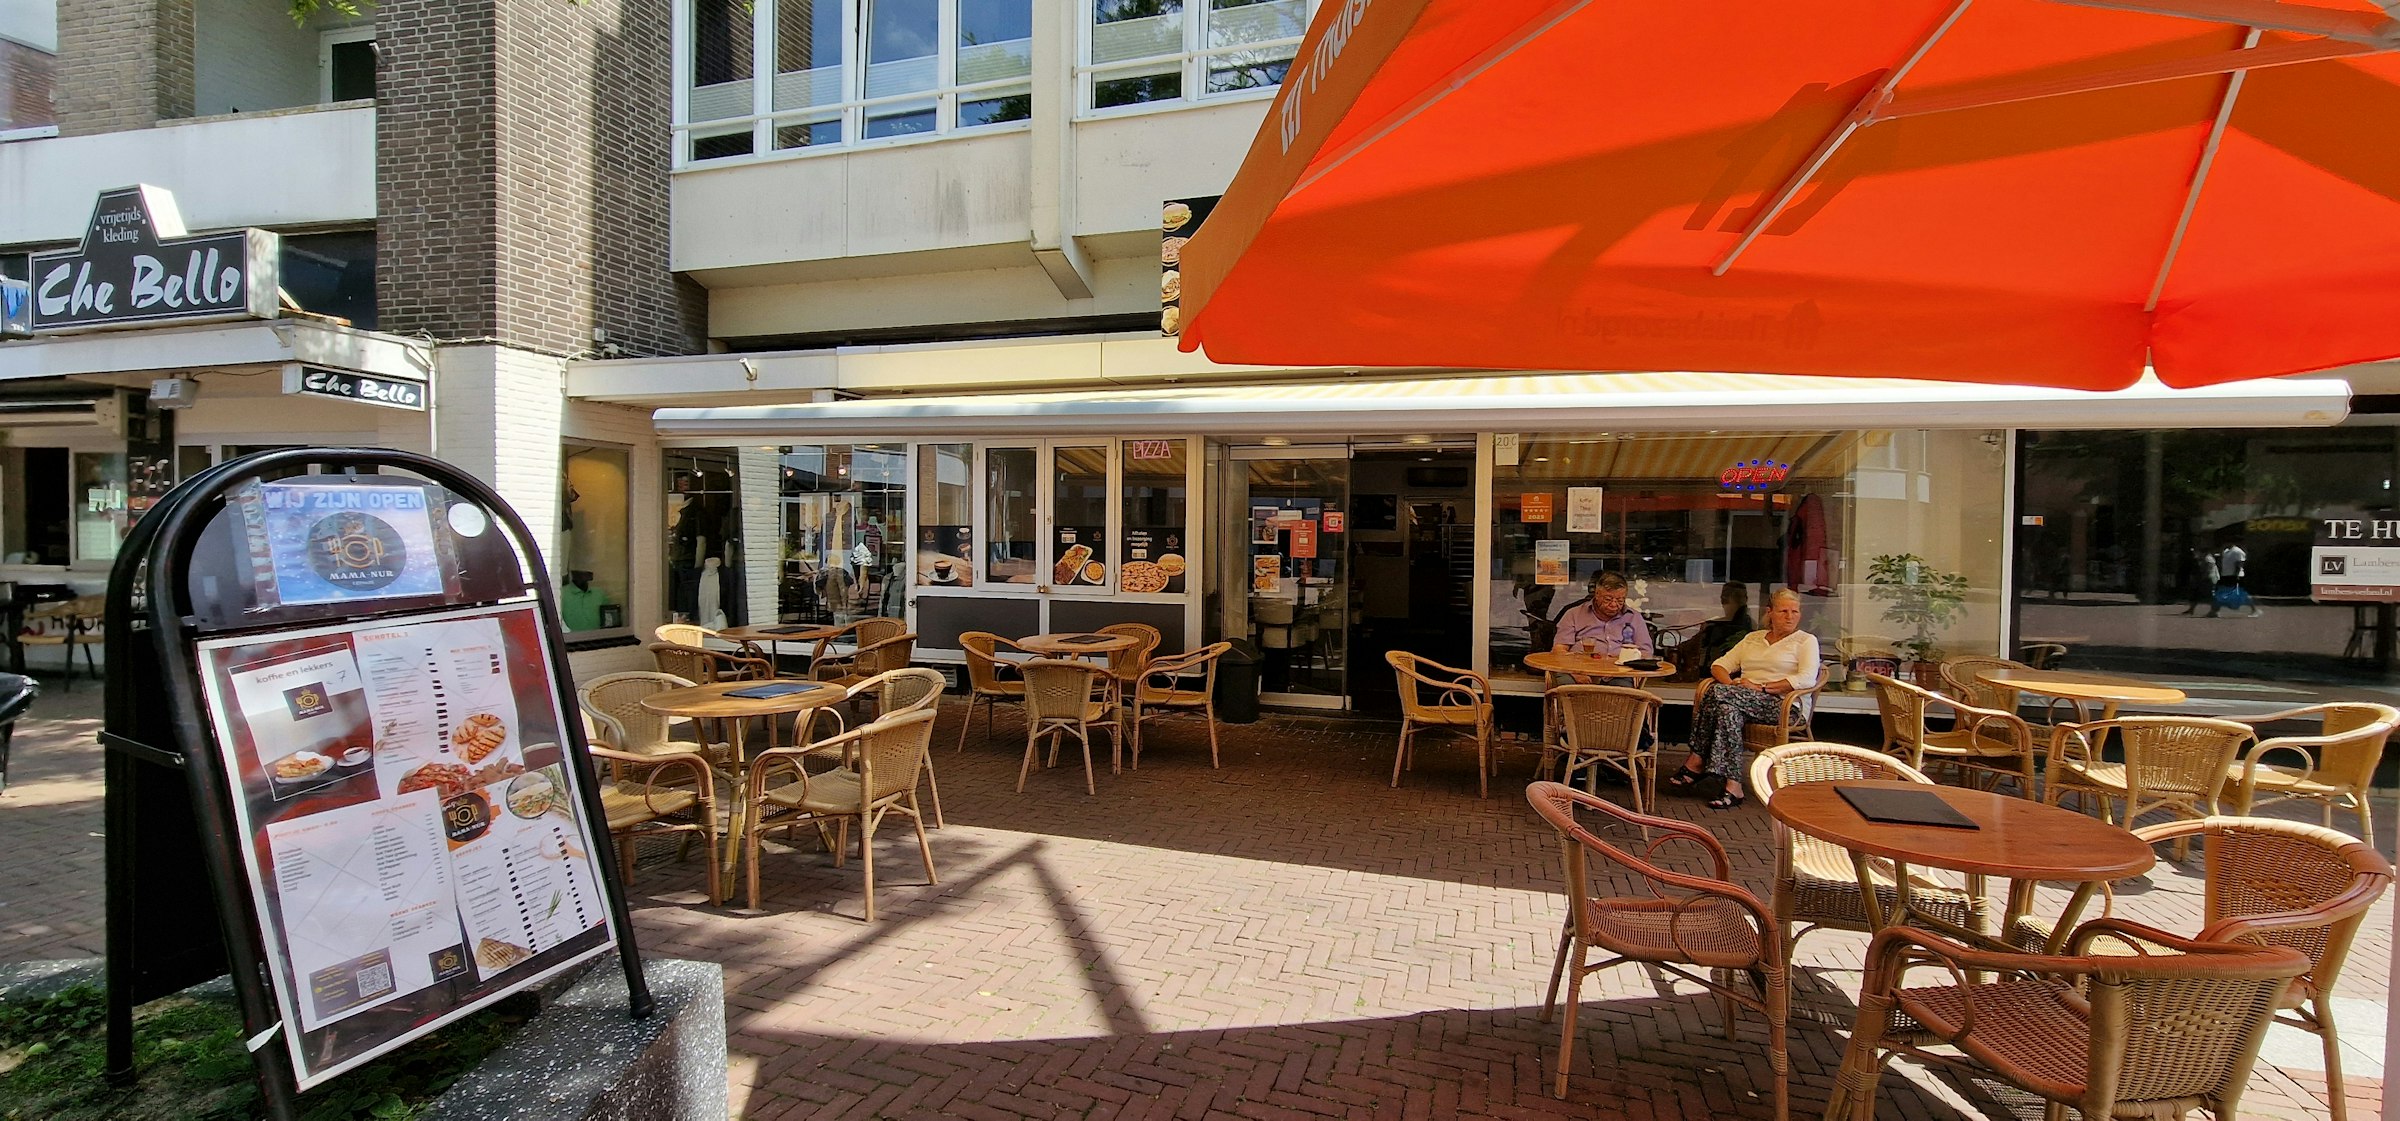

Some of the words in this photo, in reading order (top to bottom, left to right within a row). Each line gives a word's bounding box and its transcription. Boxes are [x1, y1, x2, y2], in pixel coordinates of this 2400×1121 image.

[100, 206, 142, 228] vrijetijds
[103, 227, 140, 244] kleding
[37, 261, 115, 316] Che
[131, 247, 241, 309] Bello
[305, 372, 352, 395] Che
[360, 379, 417, 404] Bello
[1133, 440, 1172, 459] PIZZA
[1721, 466, 1788, 483] OPEN
[265, 491, 305, 509] WIJ
[313, 491, 361, 509] ZIJN
[370, 491, 423, 509] OPEN
[2324, 519, 2363, 540] TE
[329, 570, 394, 581] MAMA-NUR
[2324, 561, 2344, 572] LV
[256, 673, 284, 685] koffie
[286, 669, 299, 678] en
[301, 660, 334, 674] lekkers
